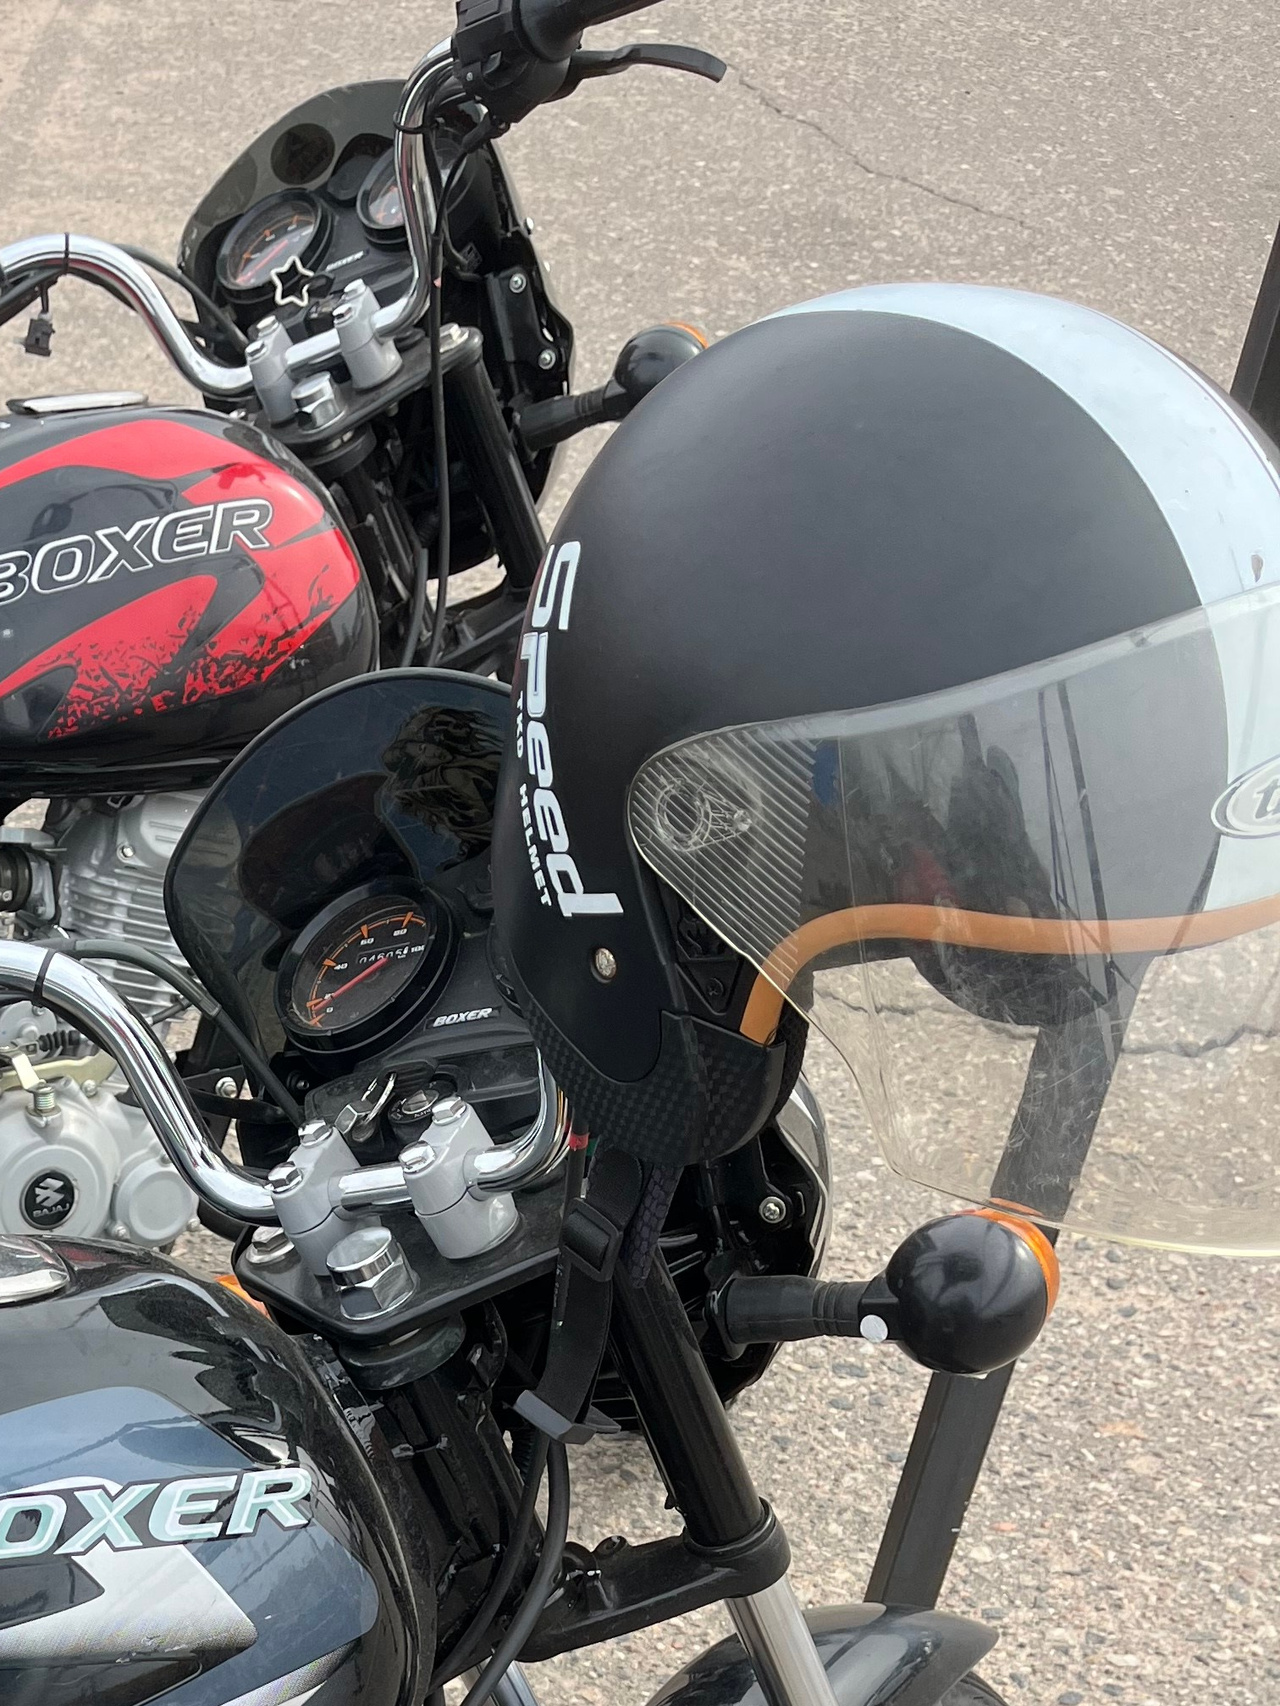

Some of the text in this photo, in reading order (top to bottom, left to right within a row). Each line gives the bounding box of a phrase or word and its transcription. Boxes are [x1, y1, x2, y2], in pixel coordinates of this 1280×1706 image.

[519, 540, 624, 918] Speed
[519, 783, 552, 907] HELMET
[433, 1007, 493, 1028] BOXER
[33, 1203, 70, 1218] BAJAJ
